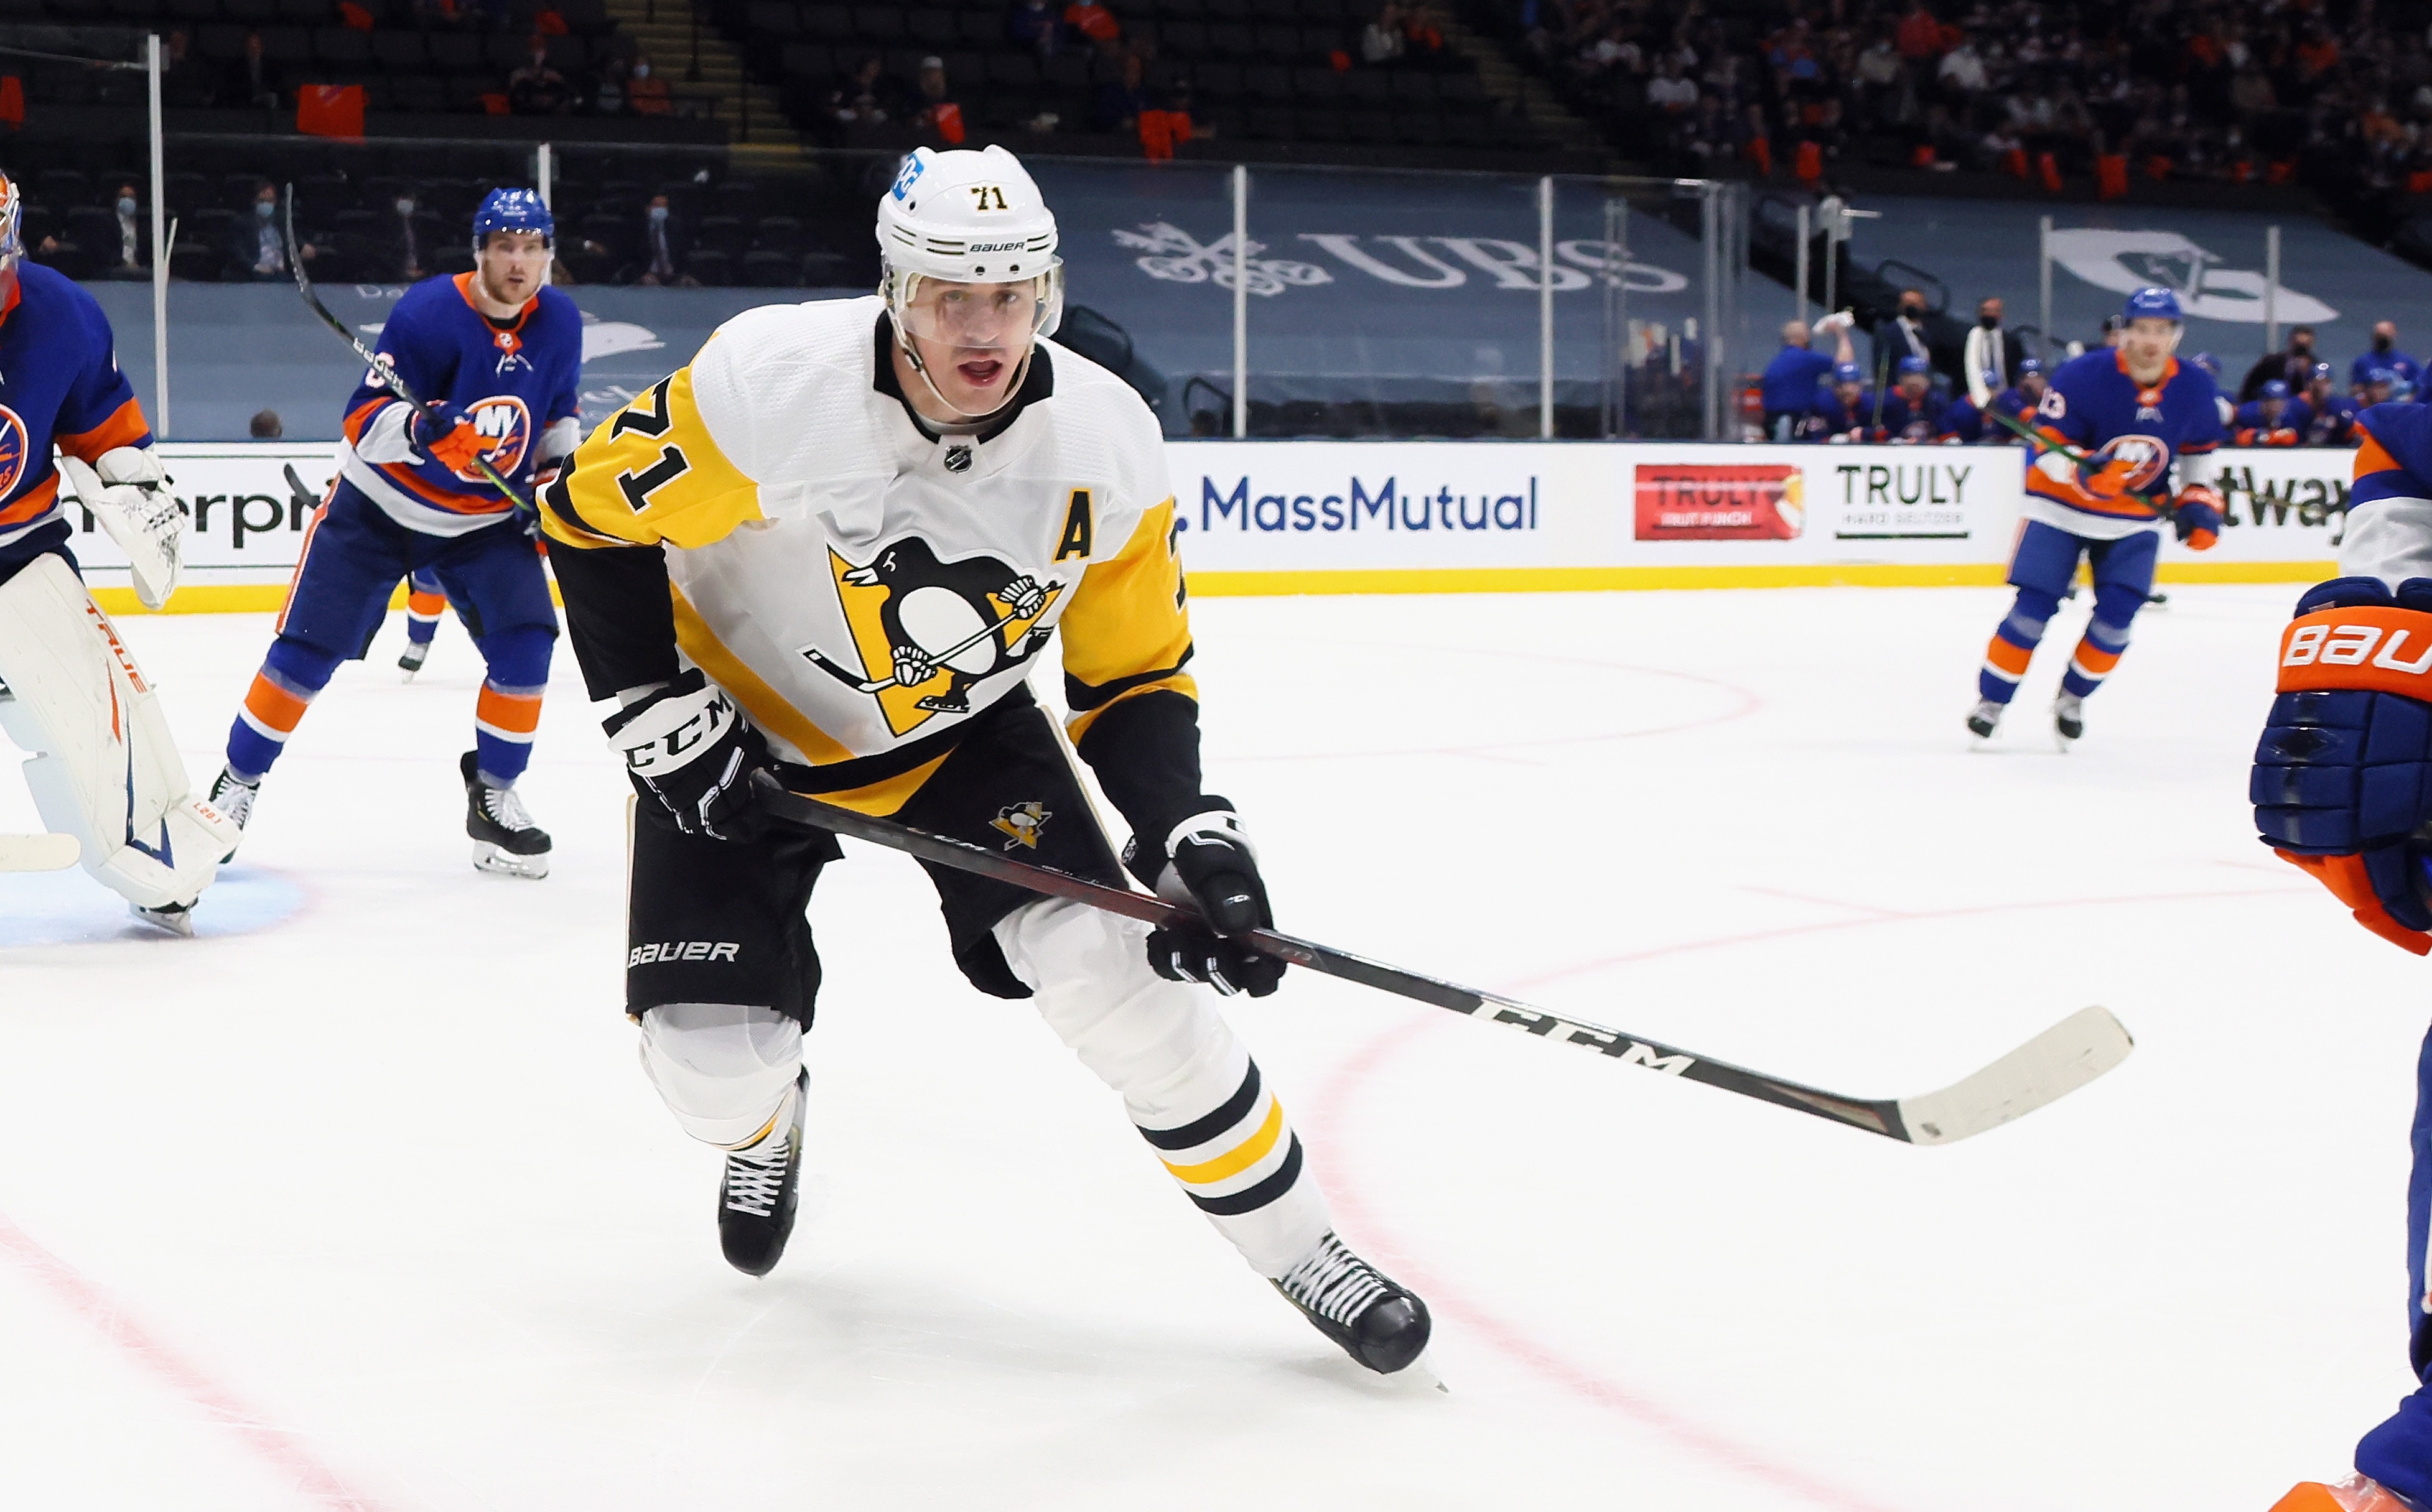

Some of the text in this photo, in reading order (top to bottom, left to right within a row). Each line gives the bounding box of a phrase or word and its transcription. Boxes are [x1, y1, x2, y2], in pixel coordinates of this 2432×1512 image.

[971, 185, 1009, 211] 71
[970, 241, 1025, 253] BAUER
[1297, 233, 1689, 292] UBS
[608, 370, 692, 516] 71
[1203, 475, 1536, 532] MassMutual
[1837, 465, 1972, 504] TRULY
[1051, 488, 1094, 565] A
[86, 598, 147, 693] TRUE
[622, 690, 733, 768] CCM
[628, 940, 740, 968] BAUER
[1471, 998, 1696, 1076] CCM
